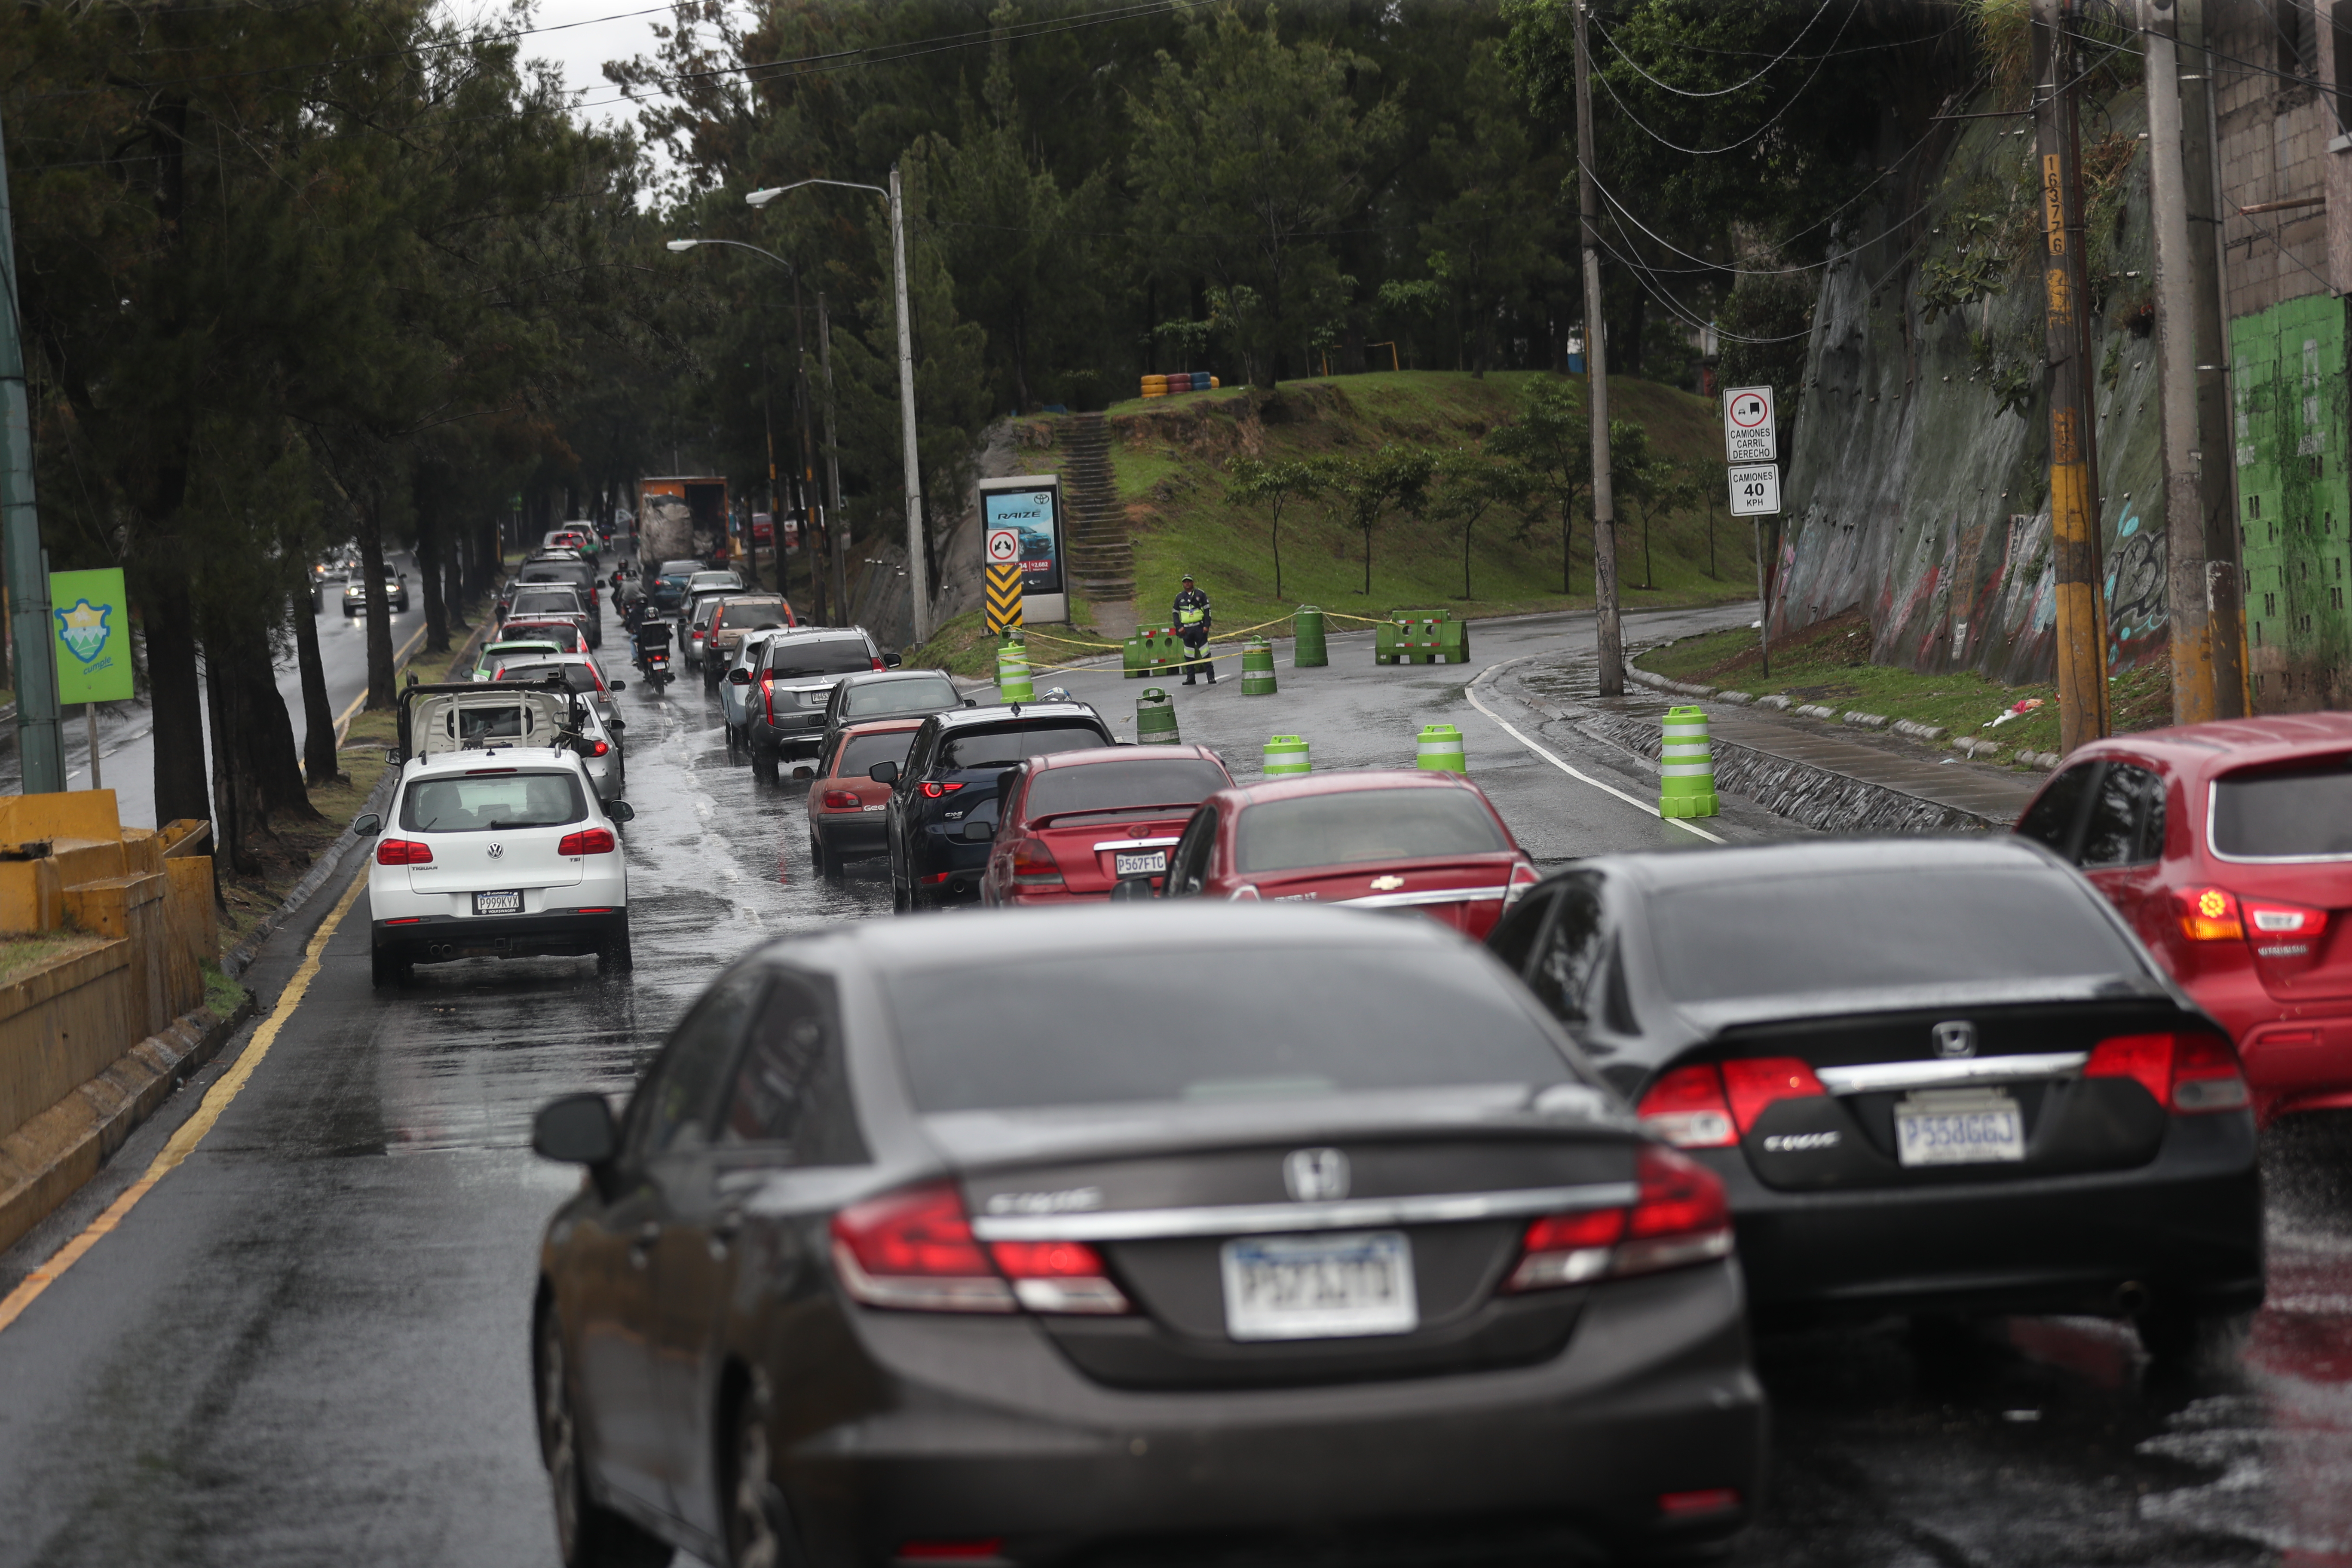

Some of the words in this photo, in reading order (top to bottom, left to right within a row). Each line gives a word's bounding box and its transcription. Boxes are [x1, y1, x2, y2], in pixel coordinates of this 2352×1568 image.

[2048, 156, 2062, 252] 163776
[1730, 428, 1770, 439] CAMIONES
[1737, 439, 1765, 449] CARRIL
[1733, 448, 1770, 459] DERECHO
[1733, 472, 1773, 483] CAMIONES
[1744, 483, 1764, 497] 40
[1746, 499, 1764, 507] KPH
[998, 511, 1041, 520] RAIZE
[83, 656, 112, 675] cumple
[1118, 856, 1164, 871] P567FTC
[480, 896, 518, 909] P999KYX
